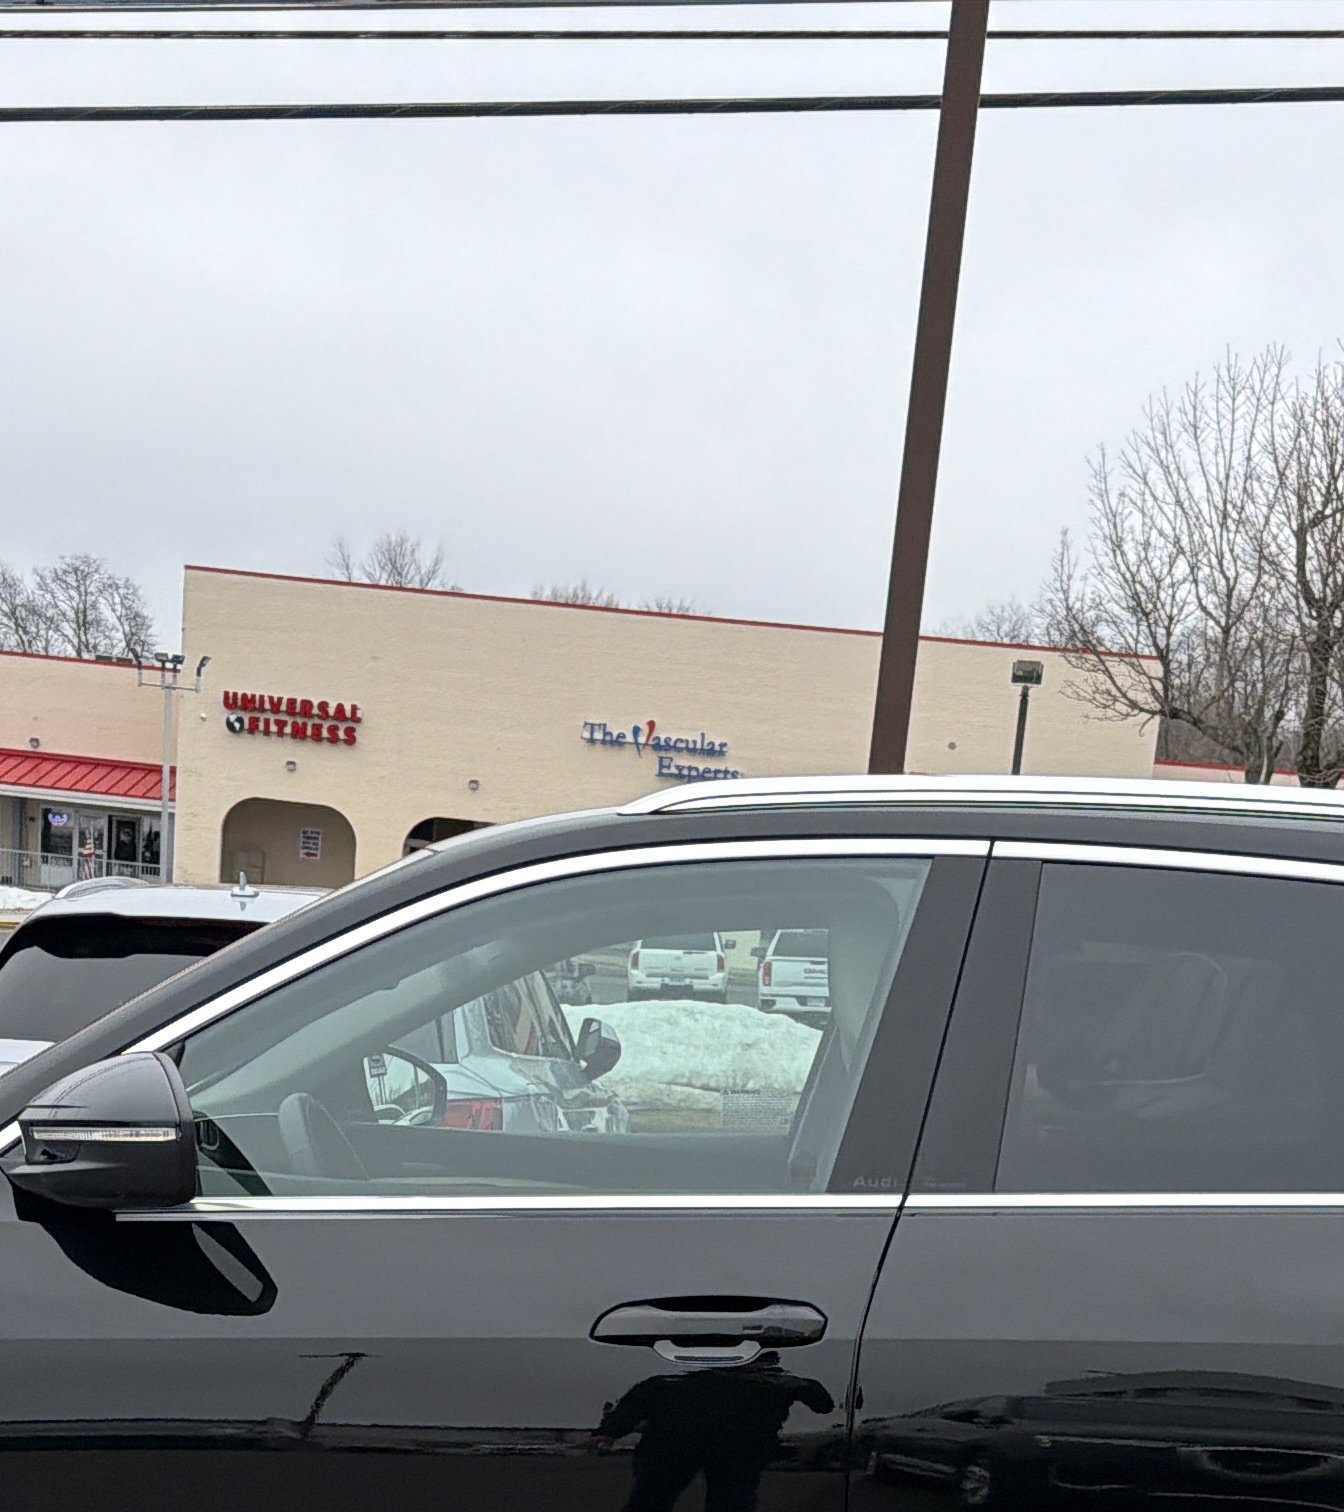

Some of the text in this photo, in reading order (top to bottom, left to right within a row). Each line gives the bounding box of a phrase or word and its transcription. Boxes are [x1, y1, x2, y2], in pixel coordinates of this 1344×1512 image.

[223, 690, 362, 723] UNIVERSAL
[248, 716, 357, 746] FITNESS
[581, 720, 728, 758] The Vascular
[656, 756, 740, 783] Experts
[853, 1176, 898, 1188] Audi
